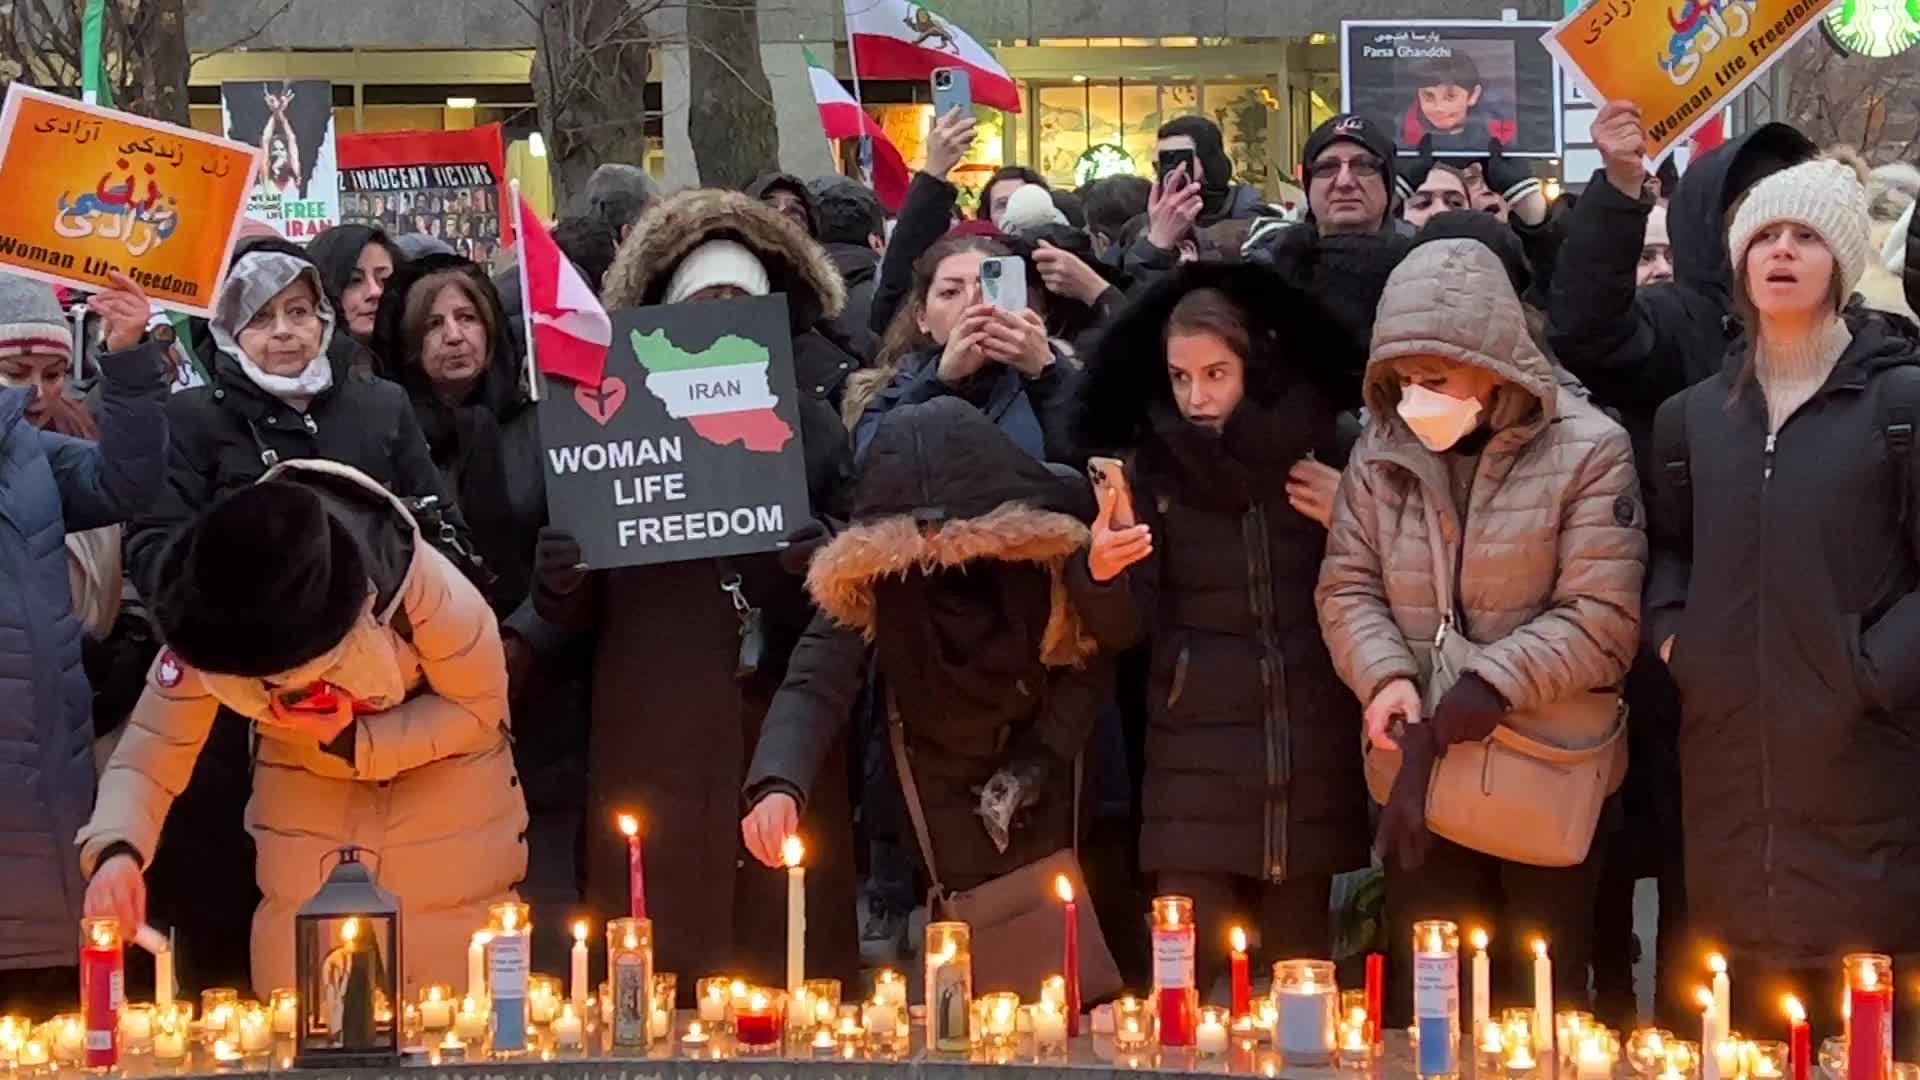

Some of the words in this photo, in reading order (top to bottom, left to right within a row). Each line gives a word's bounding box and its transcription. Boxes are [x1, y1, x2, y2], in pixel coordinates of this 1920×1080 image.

[1583, 0, 1636, 44] زادی
[1363, 46, 1394, 58] Parsa
[1649, 86, 1713, 142] Woman
[1715, 54, 1747, 87] Life
[34, 116, 103, 144] آزادی
[350, 166, 428, 190] INNOCENT
[432, 164, 493, 187] VICTIMS
[284, 201, 327, 218] FREE
[0, 234, 74, 269] Woman
[688, 379, 742, 400] IRAN
[549, 436, 683, 475] WOMAN
[613, 473, 687, 505] LIFE
[617, 505, 784, 547] FREEDOM
